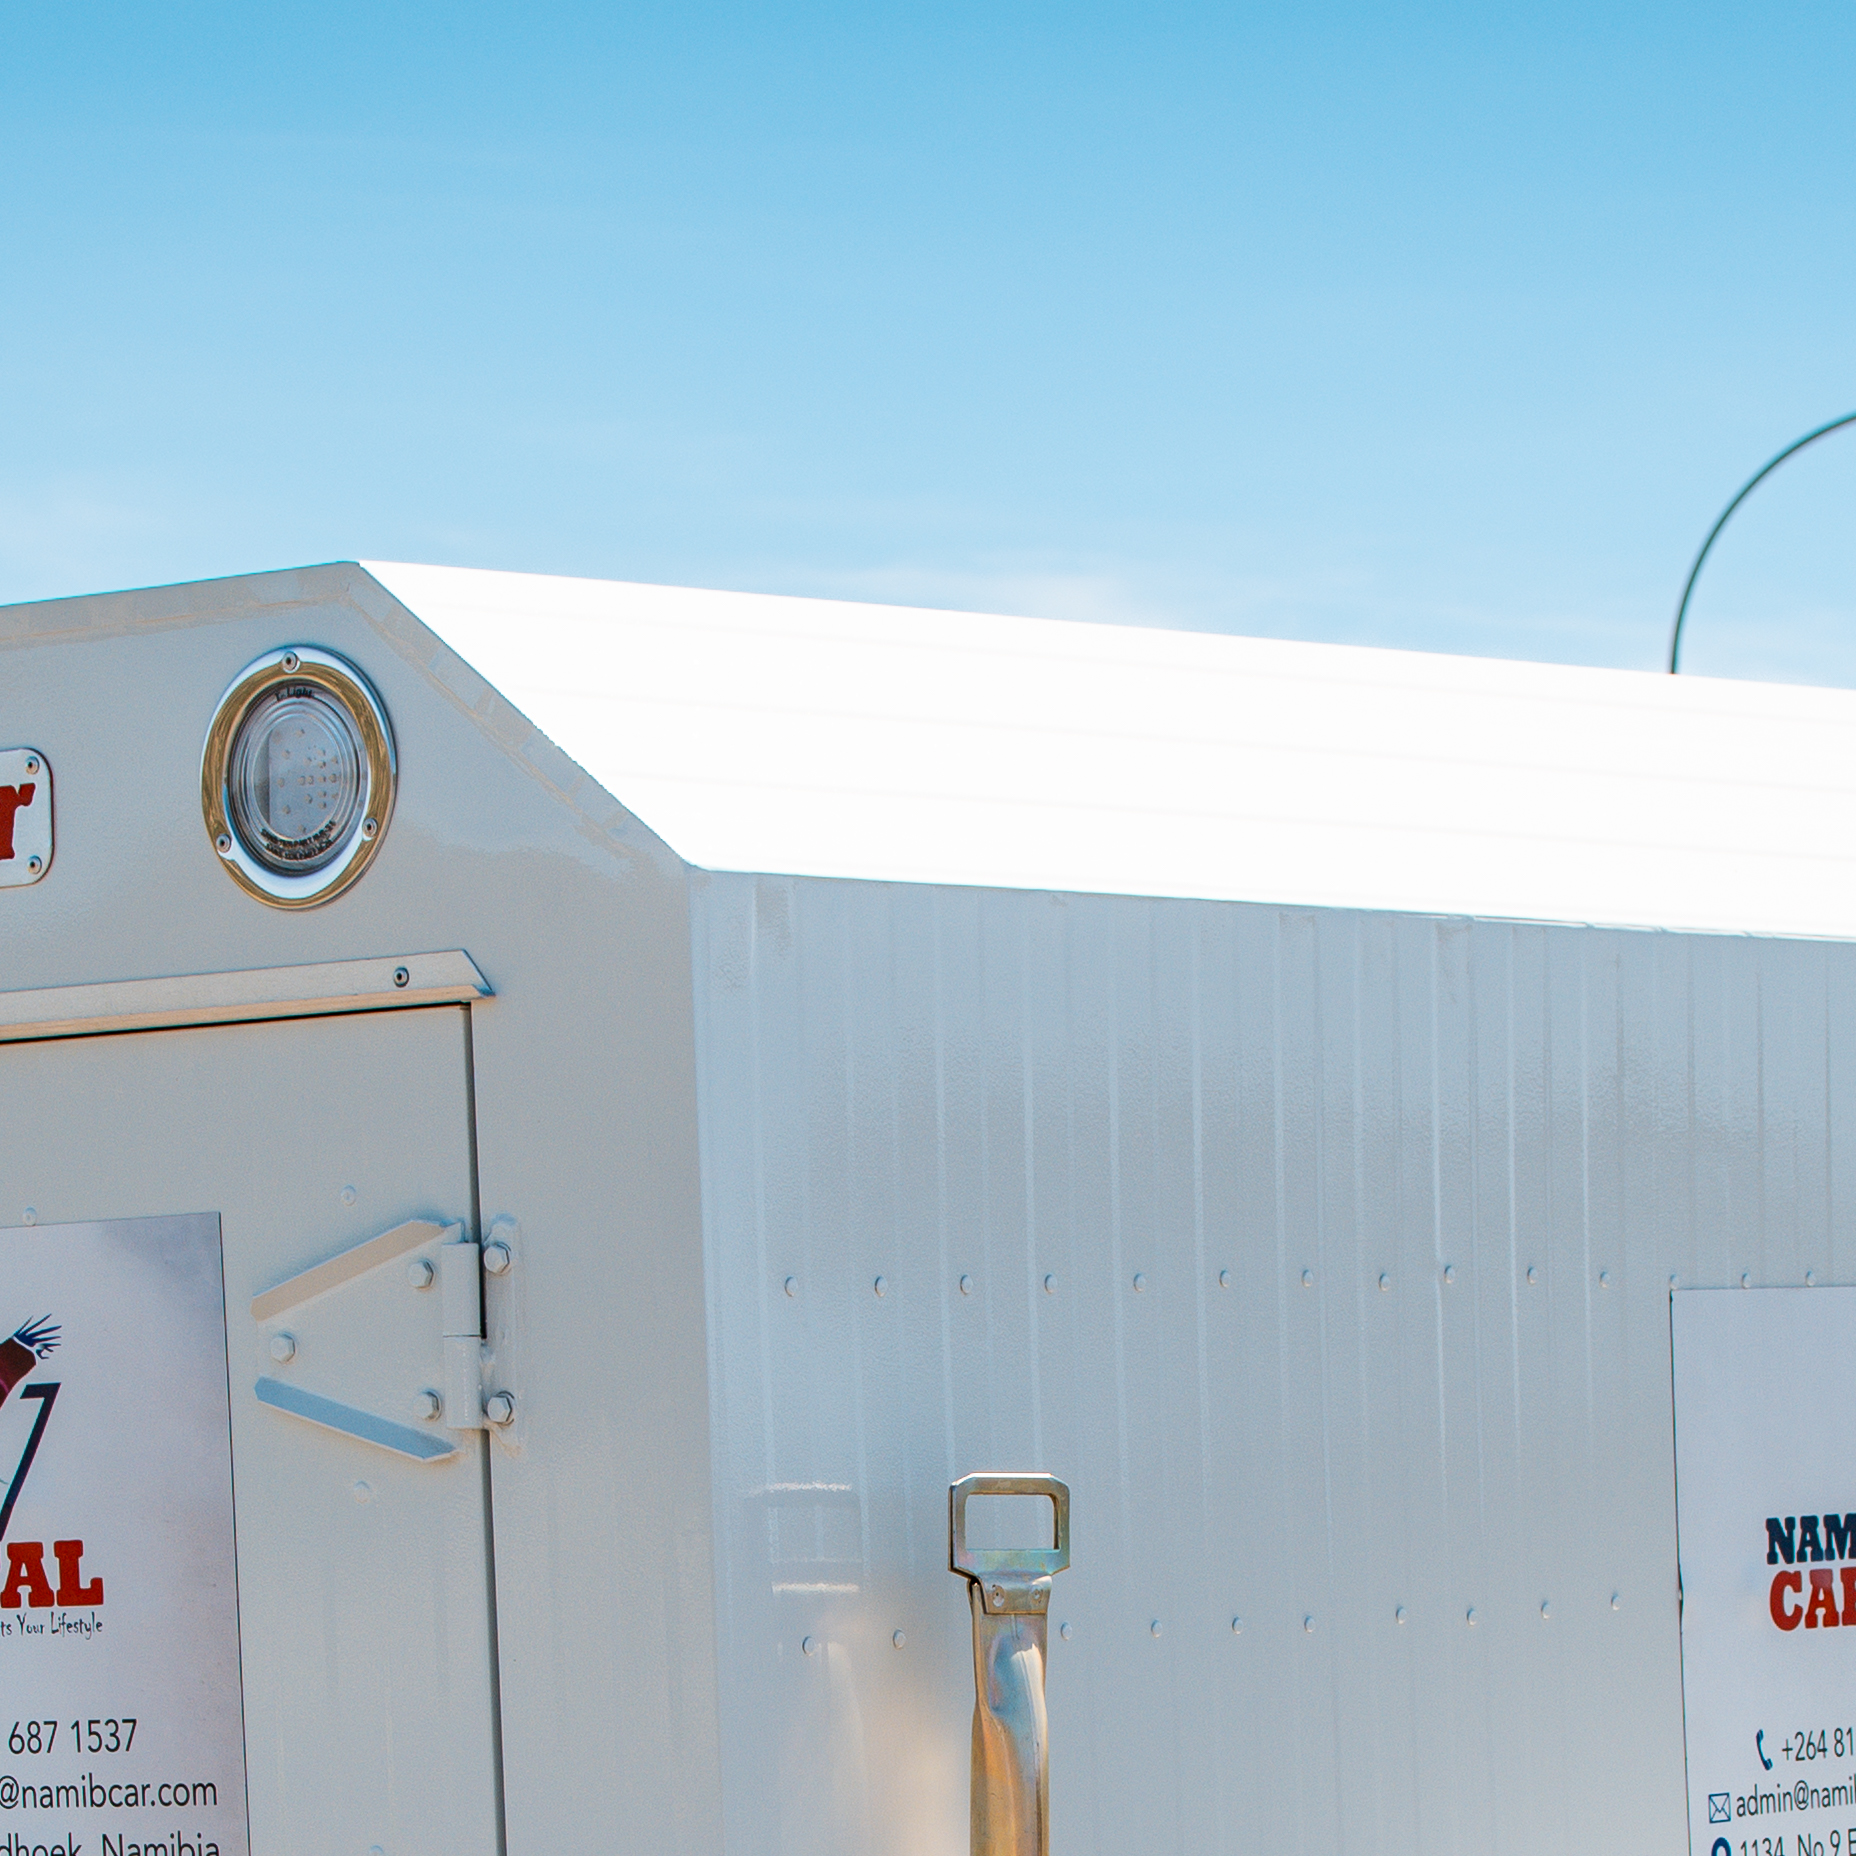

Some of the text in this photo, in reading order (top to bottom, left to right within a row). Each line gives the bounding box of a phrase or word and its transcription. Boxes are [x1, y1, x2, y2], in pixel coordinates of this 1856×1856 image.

[16, 1612, 45, 1636] Your
[50, 1611, 103, 1640] Lifestyle
[8, 1720, 58, 1754] 687
[70, 1719, 137, 1753] 1537
[1782, 1729, 1828, 1761] +264
[1834, 1727, 1853, 1757] 81
